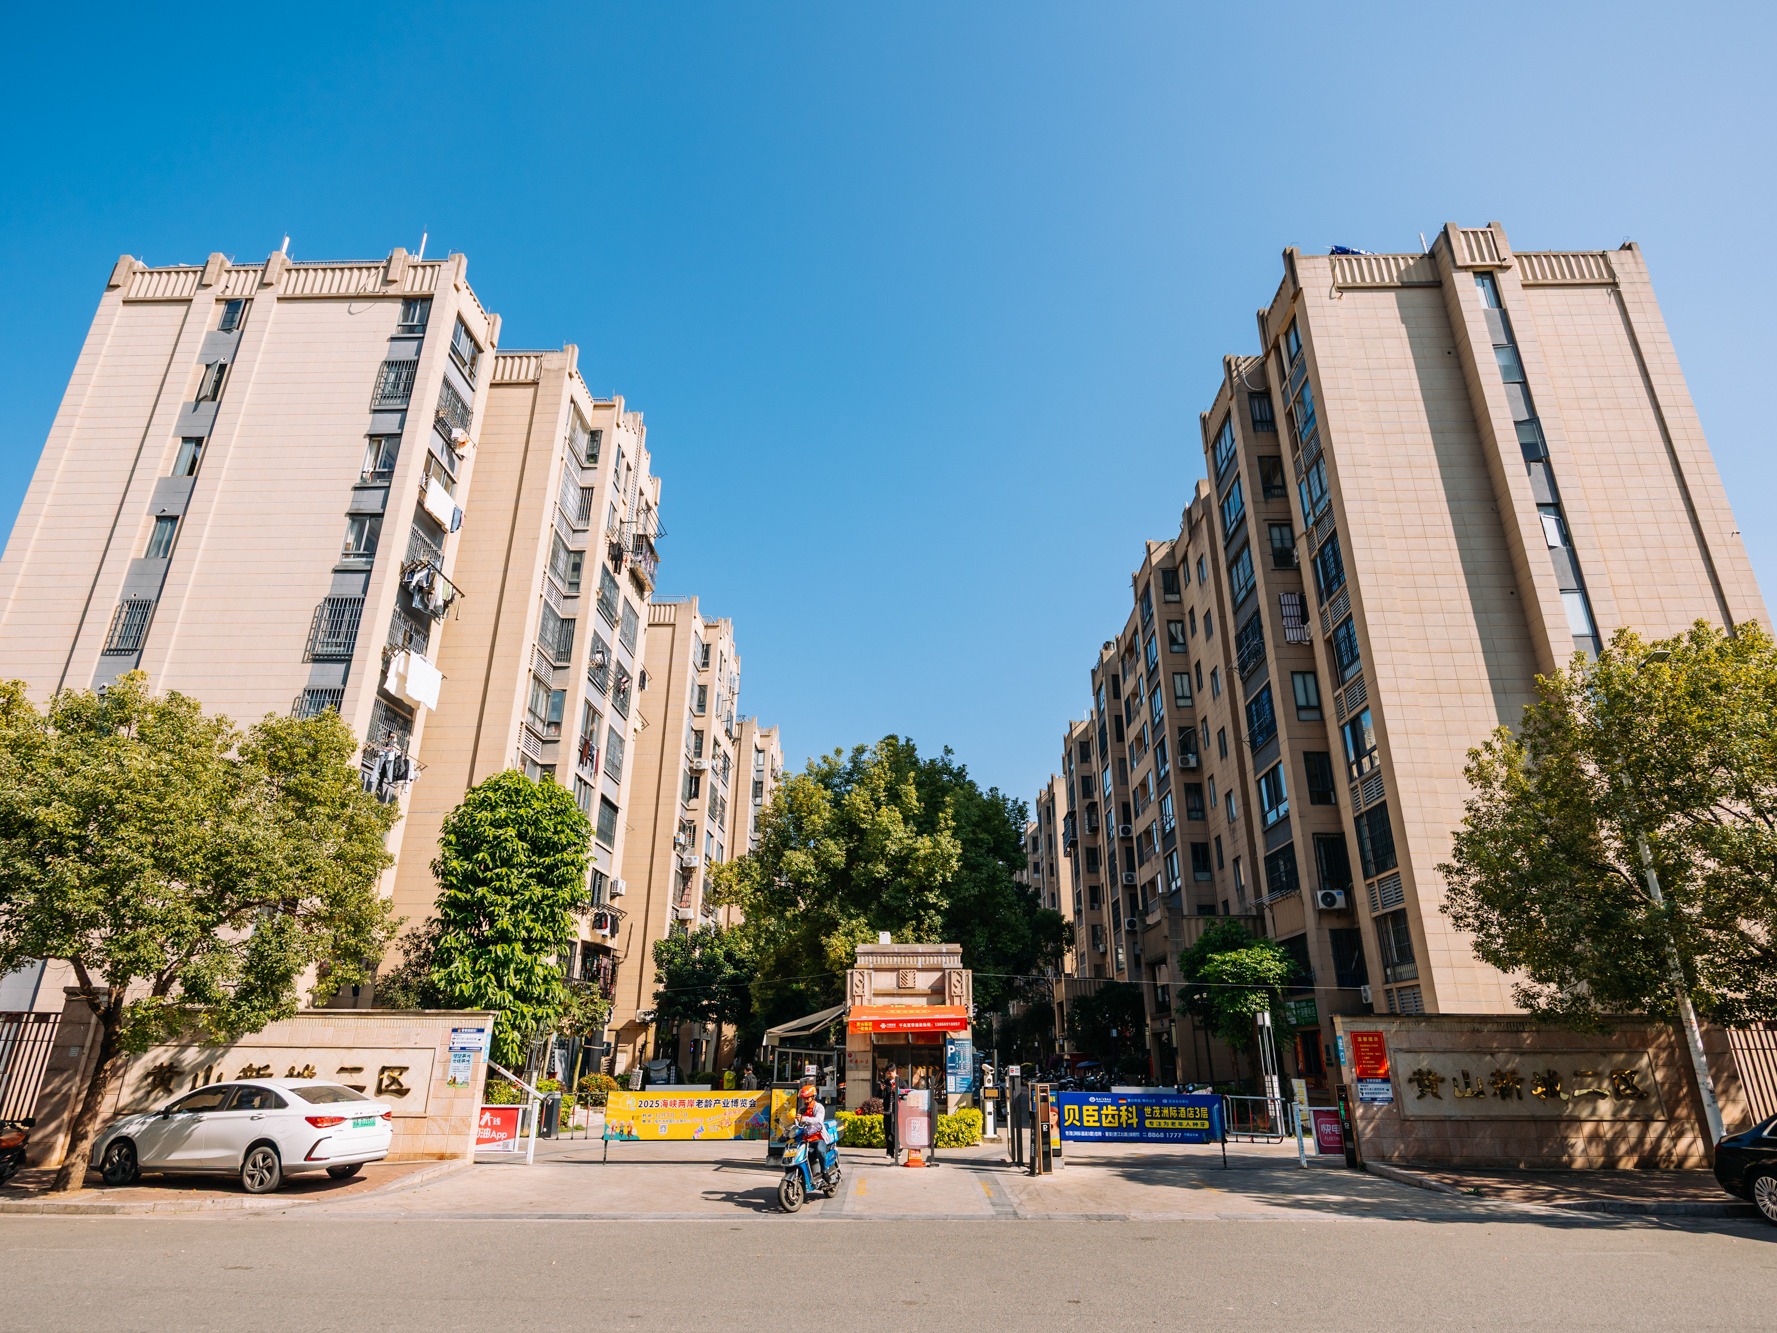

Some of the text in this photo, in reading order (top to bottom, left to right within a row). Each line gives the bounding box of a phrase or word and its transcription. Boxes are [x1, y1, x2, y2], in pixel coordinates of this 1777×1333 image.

[947, 1044, 956, 1057] P
[1407, 1067, 1648, 1101] 黄山新城二区
[638, 1098, 757, 1109] 2025海峡两岸老龄产业博览会
[1064, 1104, 1139, 1128] 贝臣齿科
[1144, 1105, 1209, 1119] 世茂洲际酒店3层
[1149, 1120, 1206, 1128] 专注为老年人种牙
[1321, 1123, 1341, 1135] 快电
